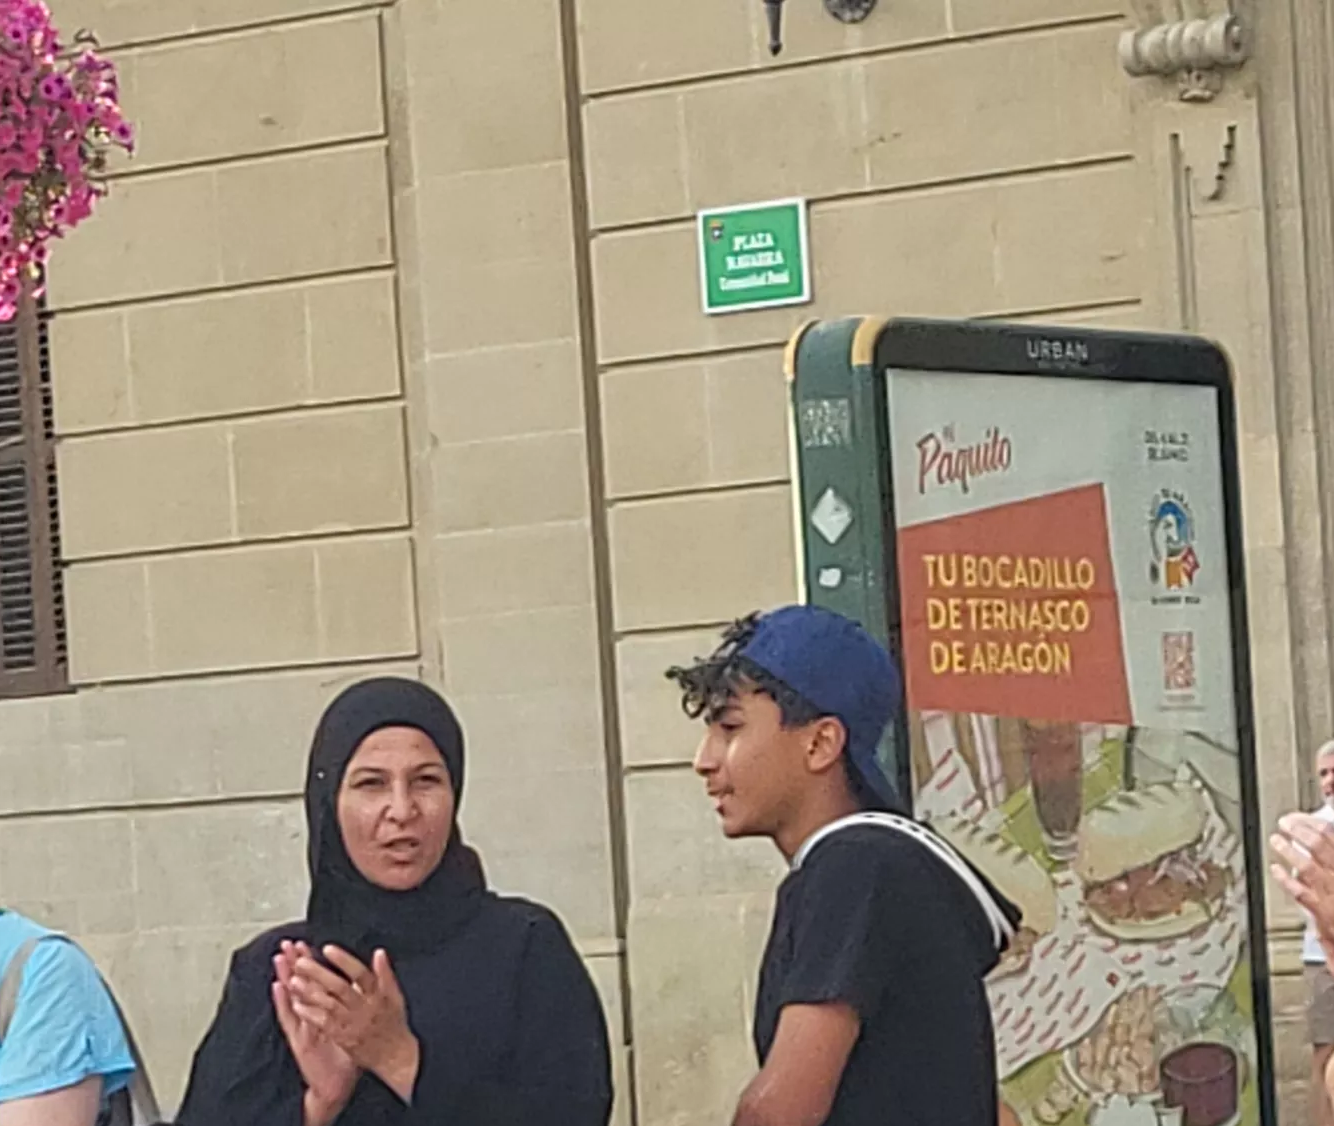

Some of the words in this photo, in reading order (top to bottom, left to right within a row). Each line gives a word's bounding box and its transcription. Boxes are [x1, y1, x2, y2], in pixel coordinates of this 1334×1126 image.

[1026, 338, 1089, 360] URBAN
[916, 426, 1012, 494] Paquito
[922, 554, 957, 587] TU
[963, 554, 1095, 589] BOCADILLO
[927, 598, 963, 630] DE
[966, 598, 1090, 631] TERNASCO
[930, 641, 967, 674] DE
[970, 632, 1072, 675] ARAGÓN
